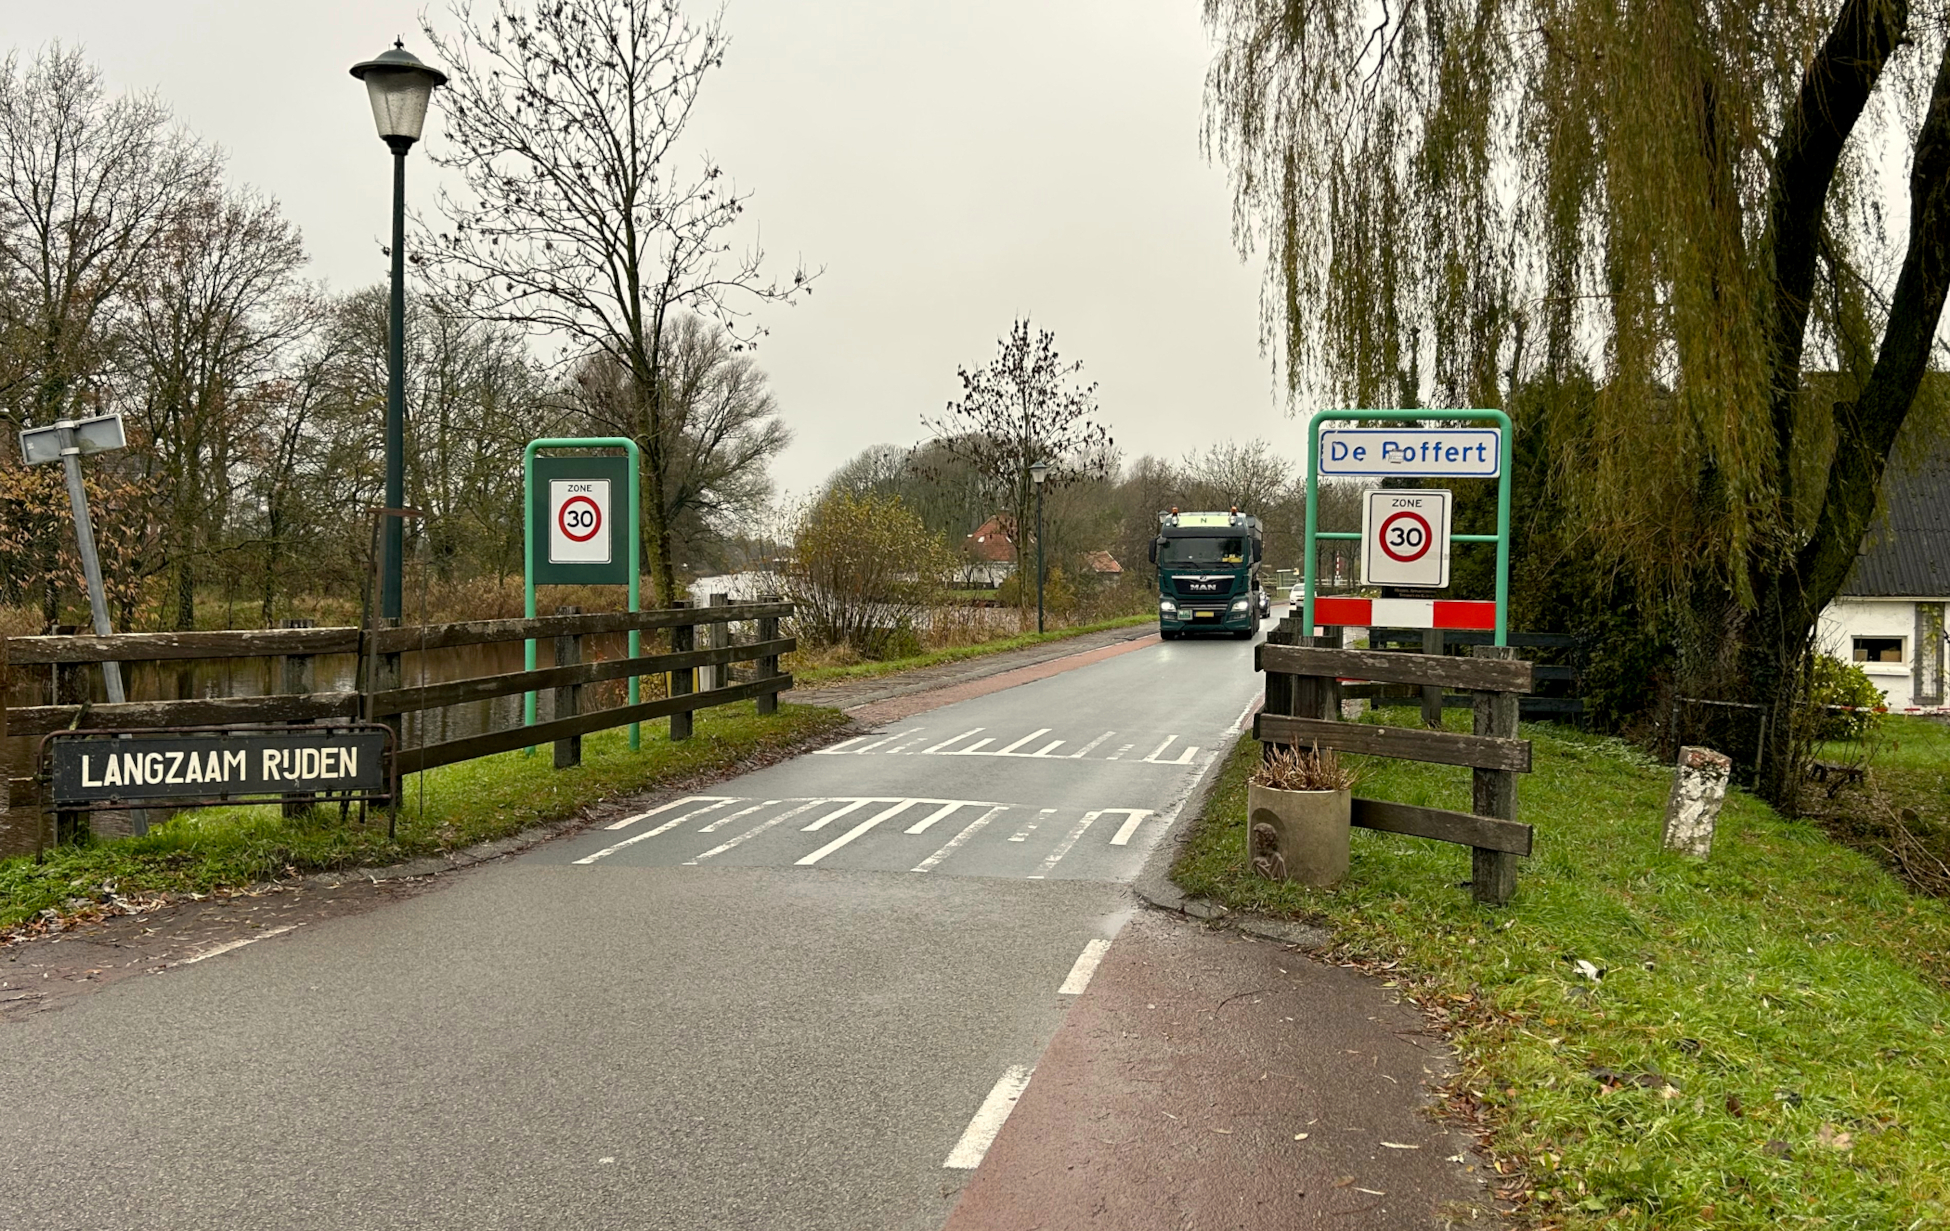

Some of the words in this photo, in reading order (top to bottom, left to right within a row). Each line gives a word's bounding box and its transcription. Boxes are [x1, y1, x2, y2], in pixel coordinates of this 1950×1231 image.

[1331, 441, 1366, 462] De
[568, 484, 592, 492] ZONE
[1391, 498, 1423, 508] ZONE
[567, 510, 593, 527] 30
[1390, 527, 1423, 547] 30
[81, 750, 247, 788] LANGZAAM
[262, 746, 358, 781] RIJDEN
